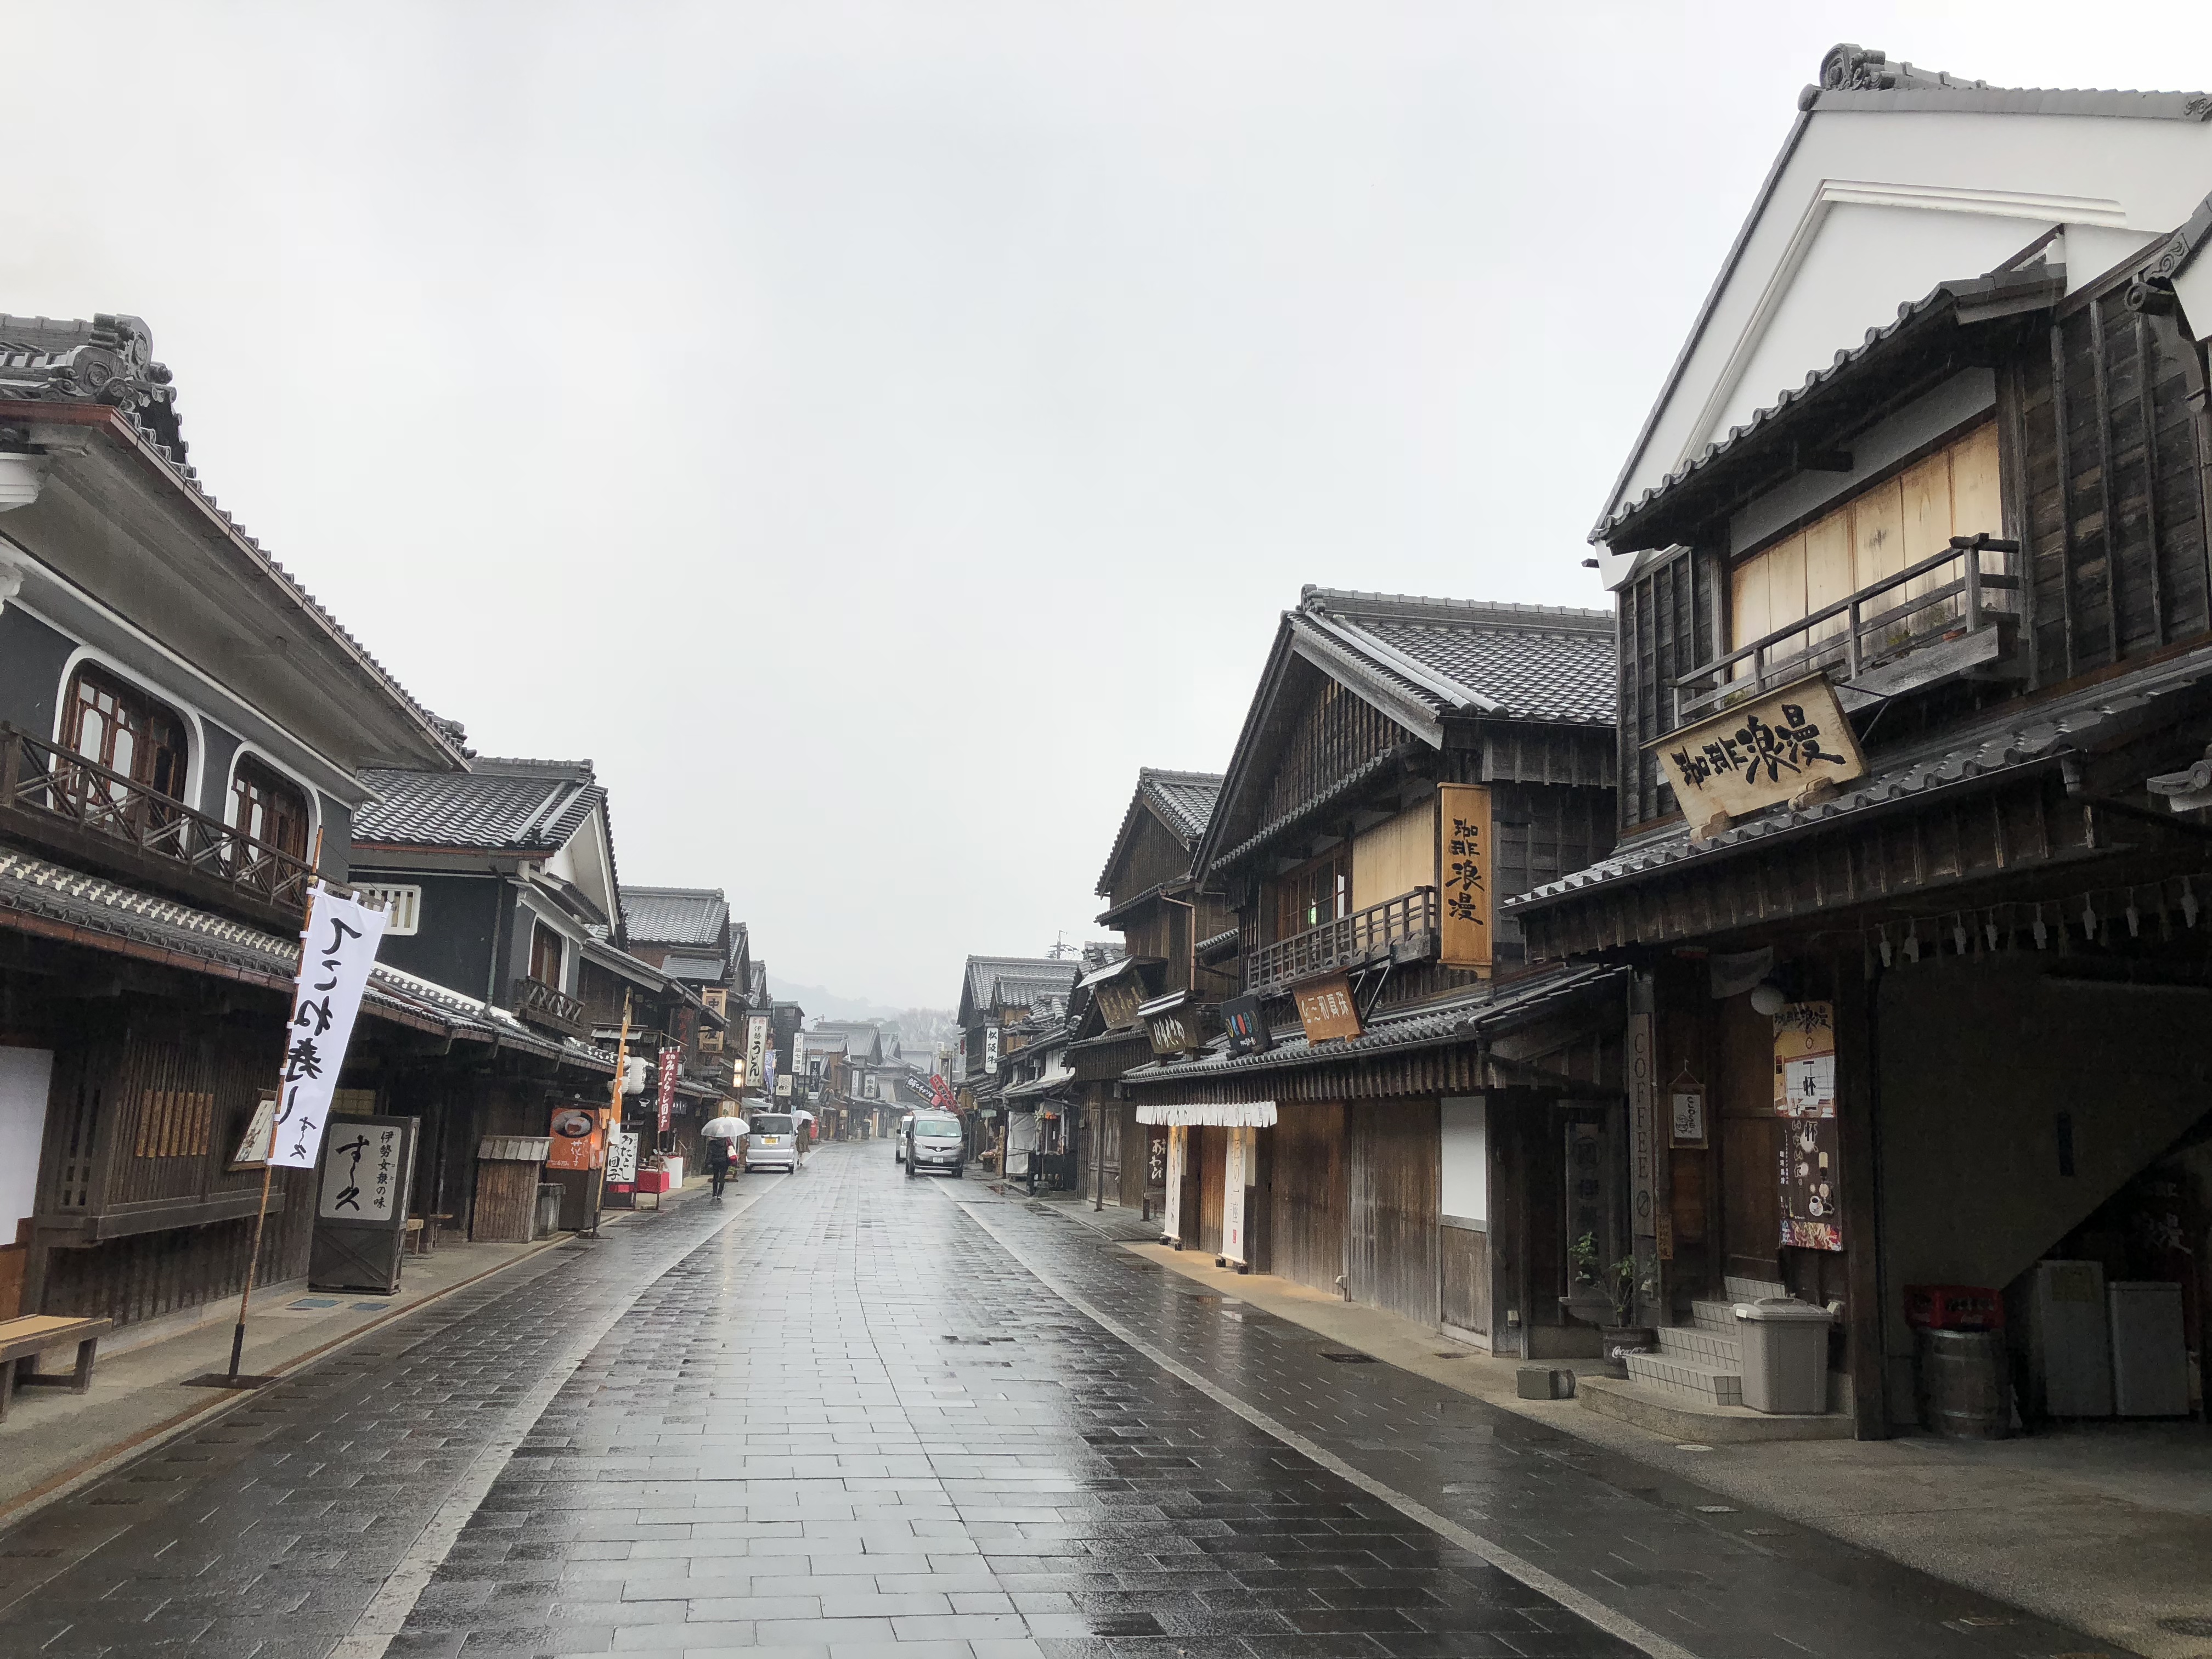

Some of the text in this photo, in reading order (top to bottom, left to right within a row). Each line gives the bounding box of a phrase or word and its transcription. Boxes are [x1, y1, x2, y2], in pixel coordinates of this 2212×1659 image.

[1671, 704, 1846, 790] 珈琲浪漫
[1445, 818, 1484, 926] 珈琲浪漫
[987, 1030, 997, 1065] 松阪牛
